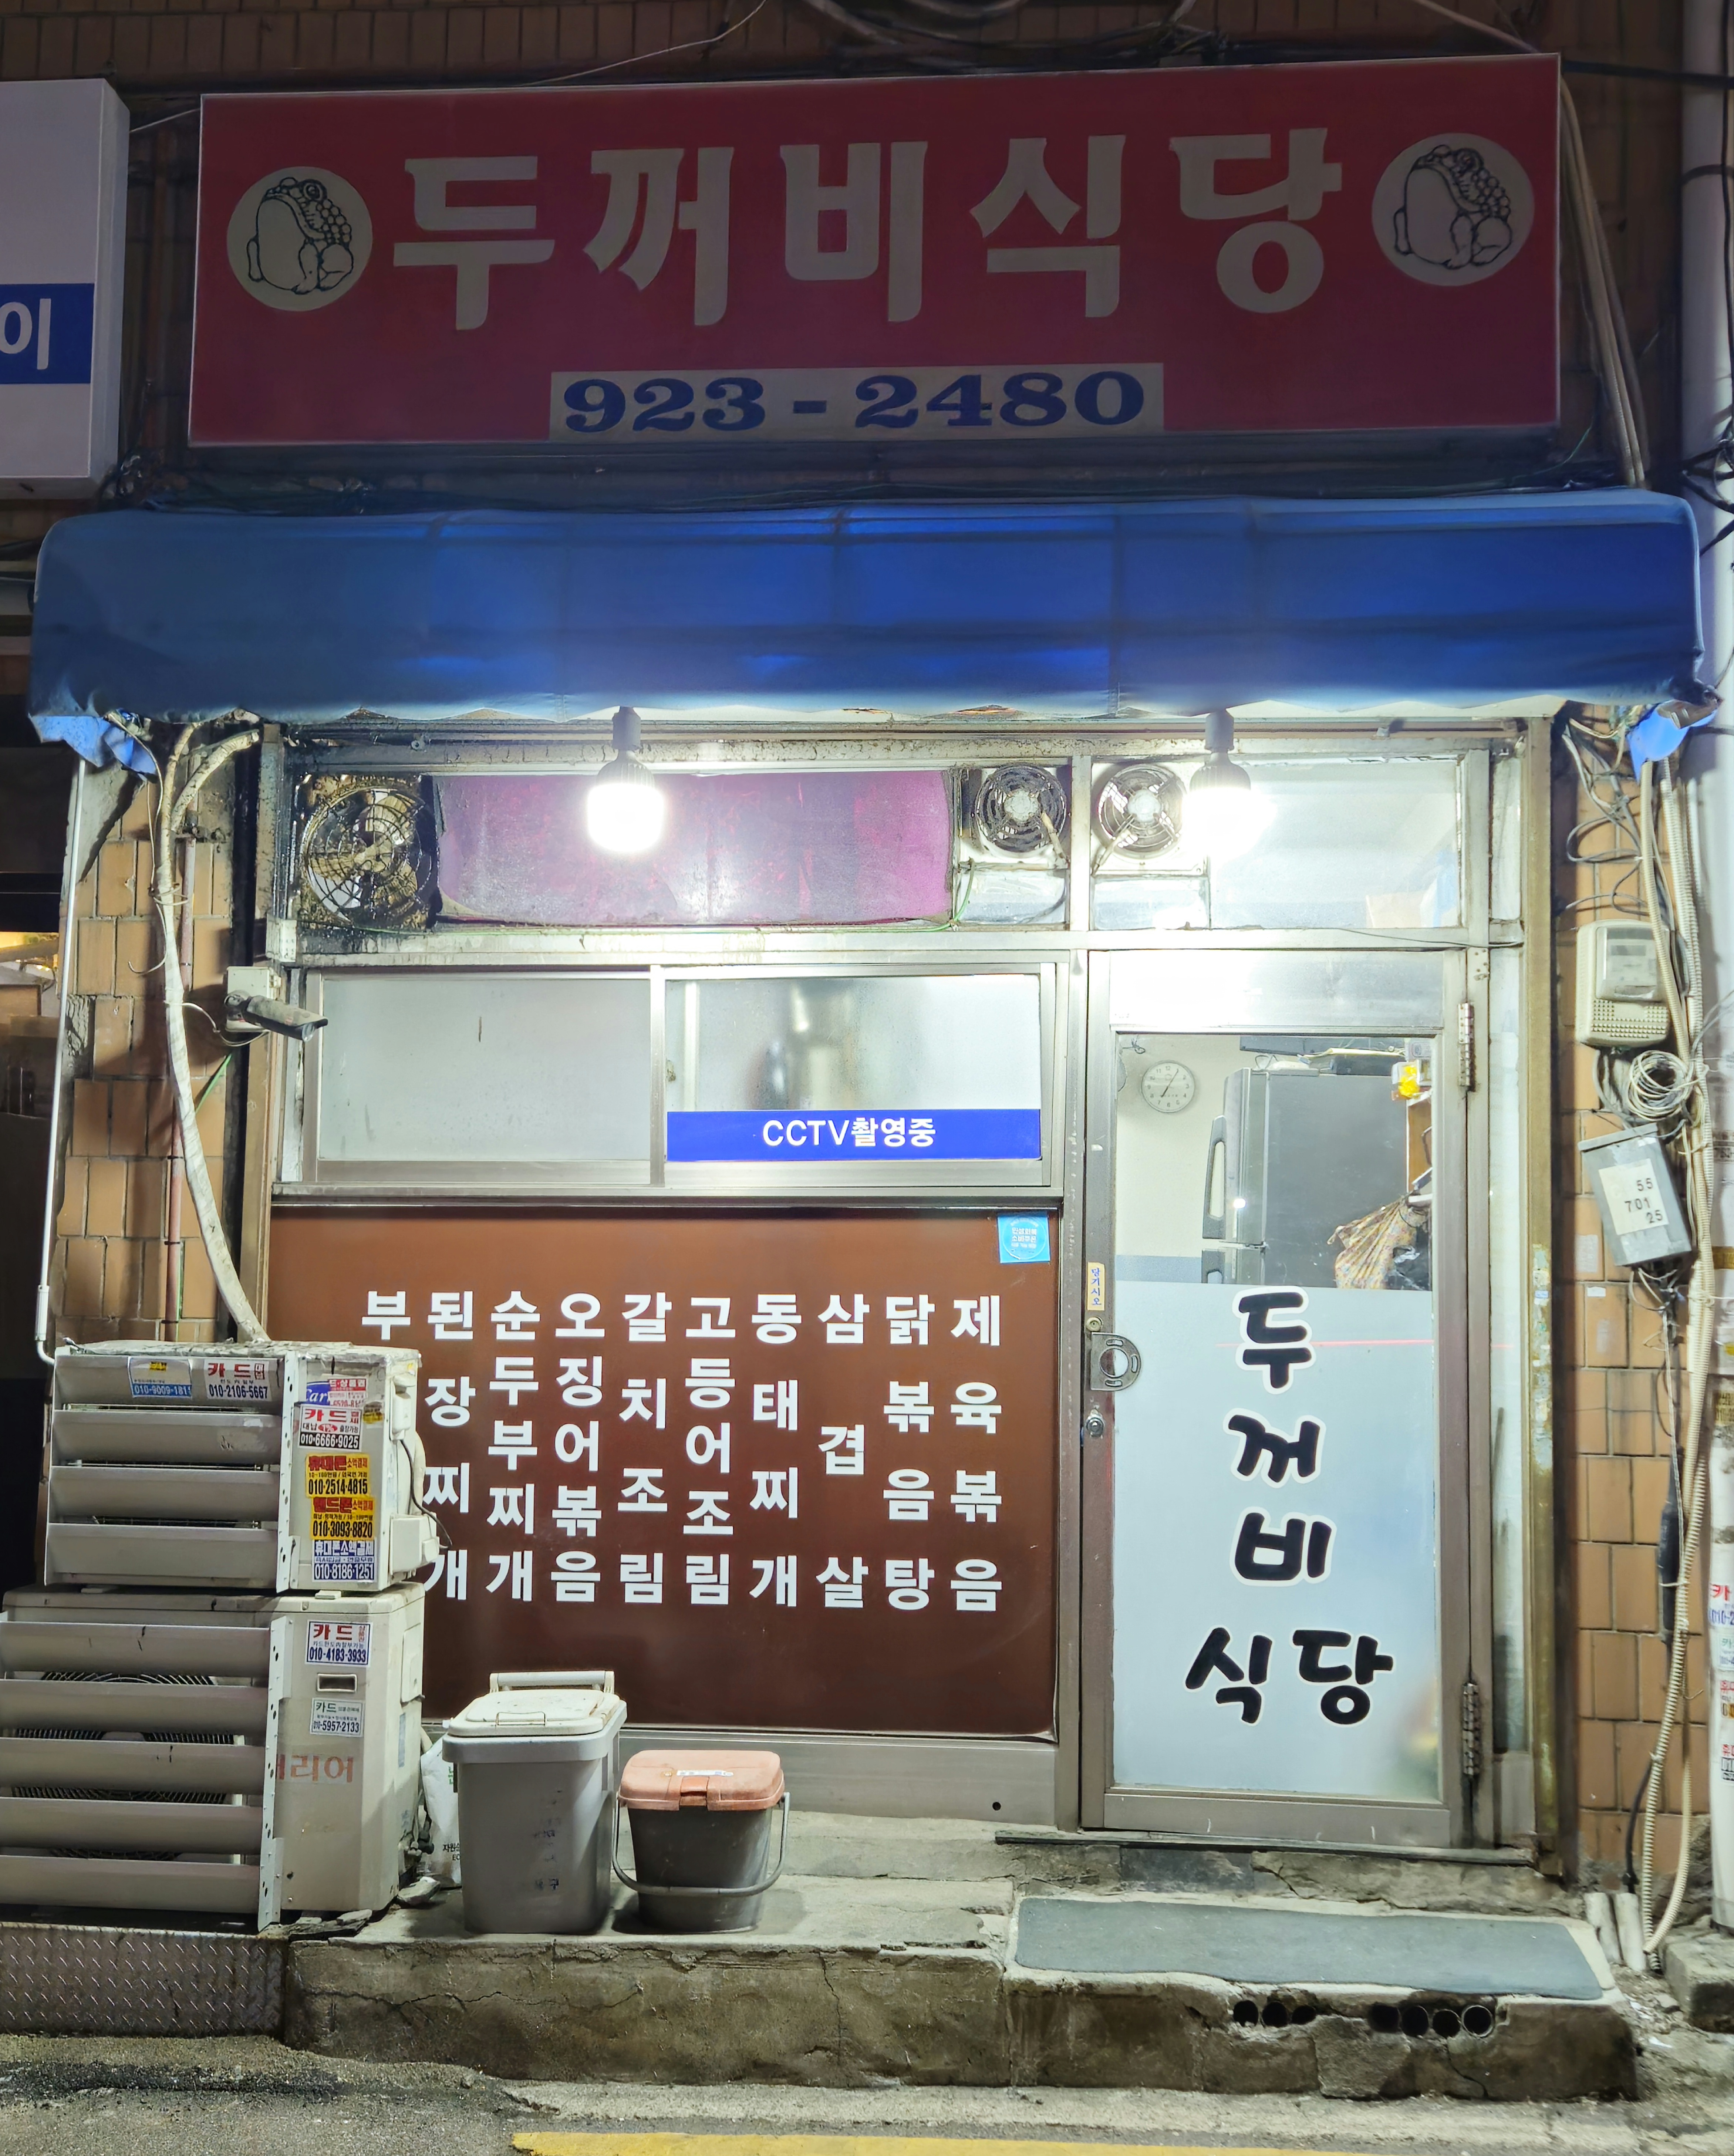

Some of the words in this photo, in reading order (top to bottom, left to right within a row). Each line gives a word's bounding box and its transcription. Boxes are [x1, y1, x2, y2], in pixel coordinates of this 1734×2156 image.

[393, 127, 1342, 330] 두꺼비식당
[762, 1117, 936, 1147] CCTV촬영중
[1624, 1197, 1651, 1213] 701
[1636, 1178, 1653, 1191] 55
[1646, 1209, 1663, 1224] 25
[209, 1384, 268, 1399] 010-2106-5667
[304, 1408, 347, 1423] 카드
[306, 1389, 329, 1402] Car
[423, 1290, 476, 1601] 된장찌개
[485, 1290, 540, 1602] 순두부찌개
[550, 1292, 605, 1603] 오징어볶음
[617, 1292, 672, 1604] 갈치조림
[683, 1297, 736, 1605] 고등어조림
[749, 1293, 802, 1607] 동태찌개
[815, 1293, 870, 1609] 삼겹살
[883, 1293, 935, 1611] 닭볶음탕
[950, 1295, 1002, 1612] 제육볶음
[1227, 1290, 1334, 1582] 두꺼비
[309, 1647, 366, 1663] 010-4183-3933
[313, 1624, 352, 1640] 카드
[316, 1701, 336, 1713] 카드
[1184, 1627, 1394, 1725] 식당
